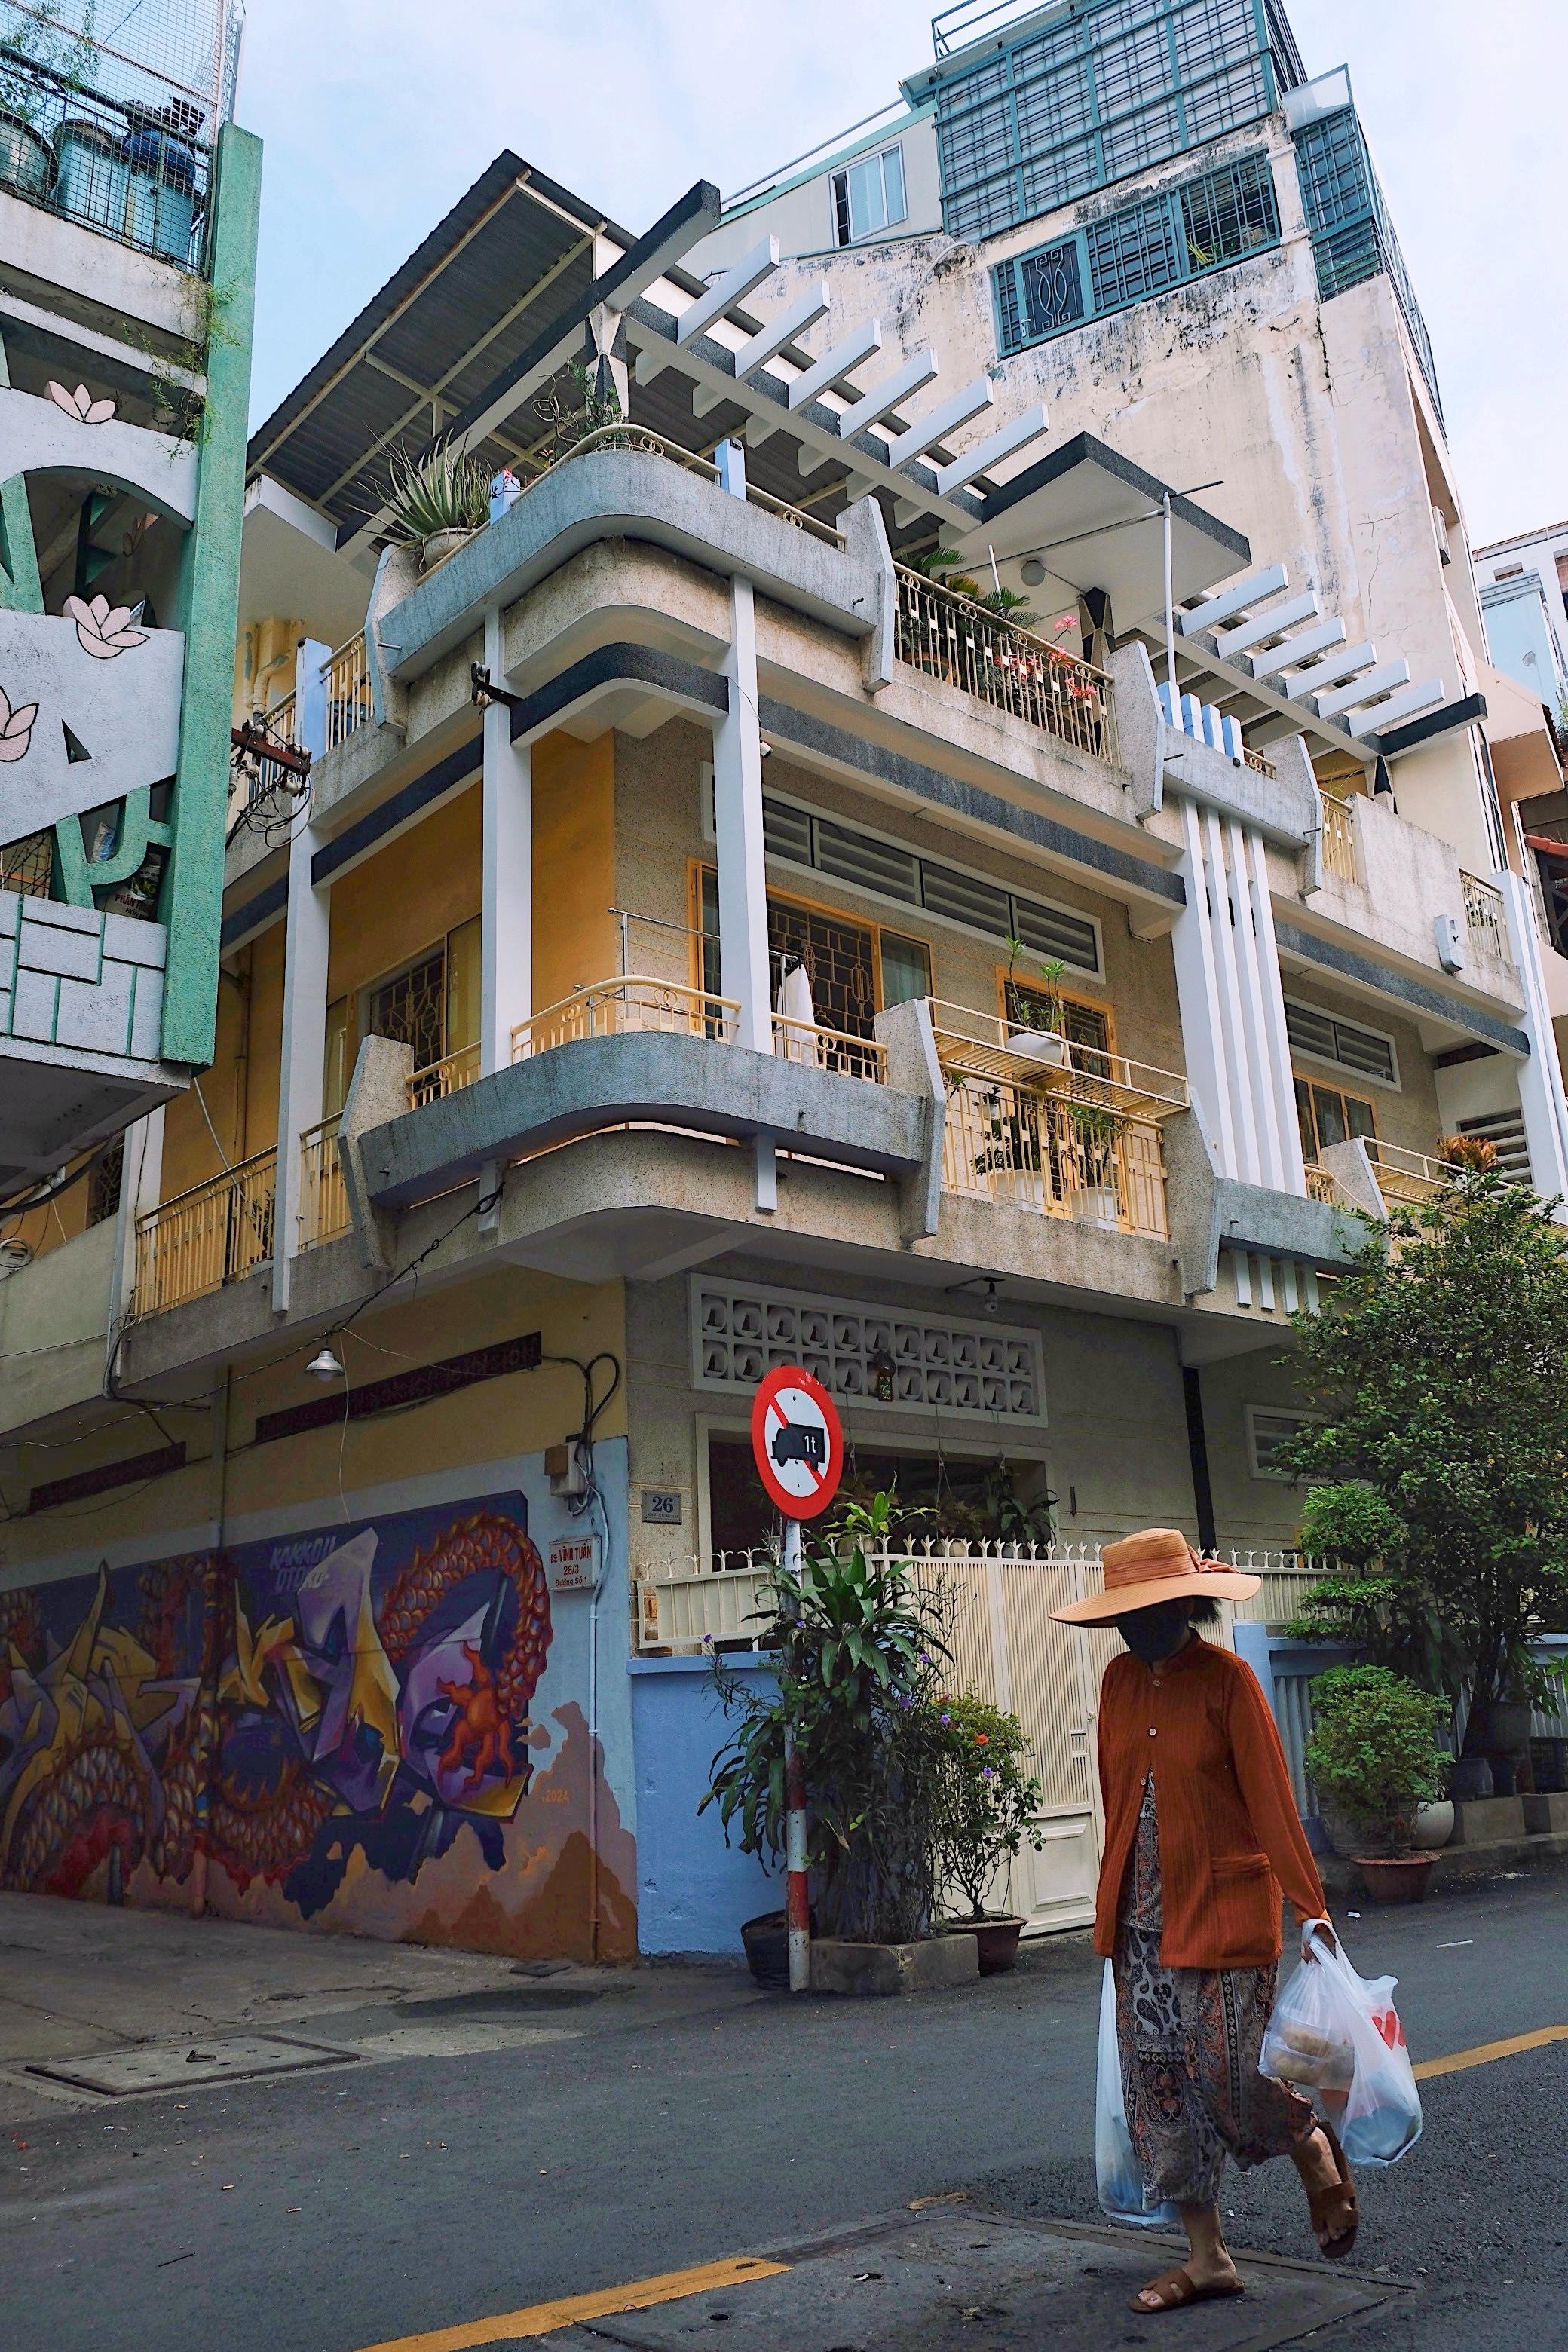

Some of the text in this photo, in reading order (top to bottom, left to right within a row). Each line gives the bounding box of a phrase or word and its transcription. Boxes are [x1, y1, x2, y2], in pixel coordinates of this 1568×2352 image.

[115, 893, 136, 907] PHÂN
[804, 1435, 816, 1453] 1t
[652, 1496, 674, 1513] 26
[550, 1540, 592, 1563] BS: VĨNH TUẤN
[563, 1564, 580, 1576] 26/3
[556, 1578, 574, 1586] Đường
[574, 1575, 583, 1585] Số
